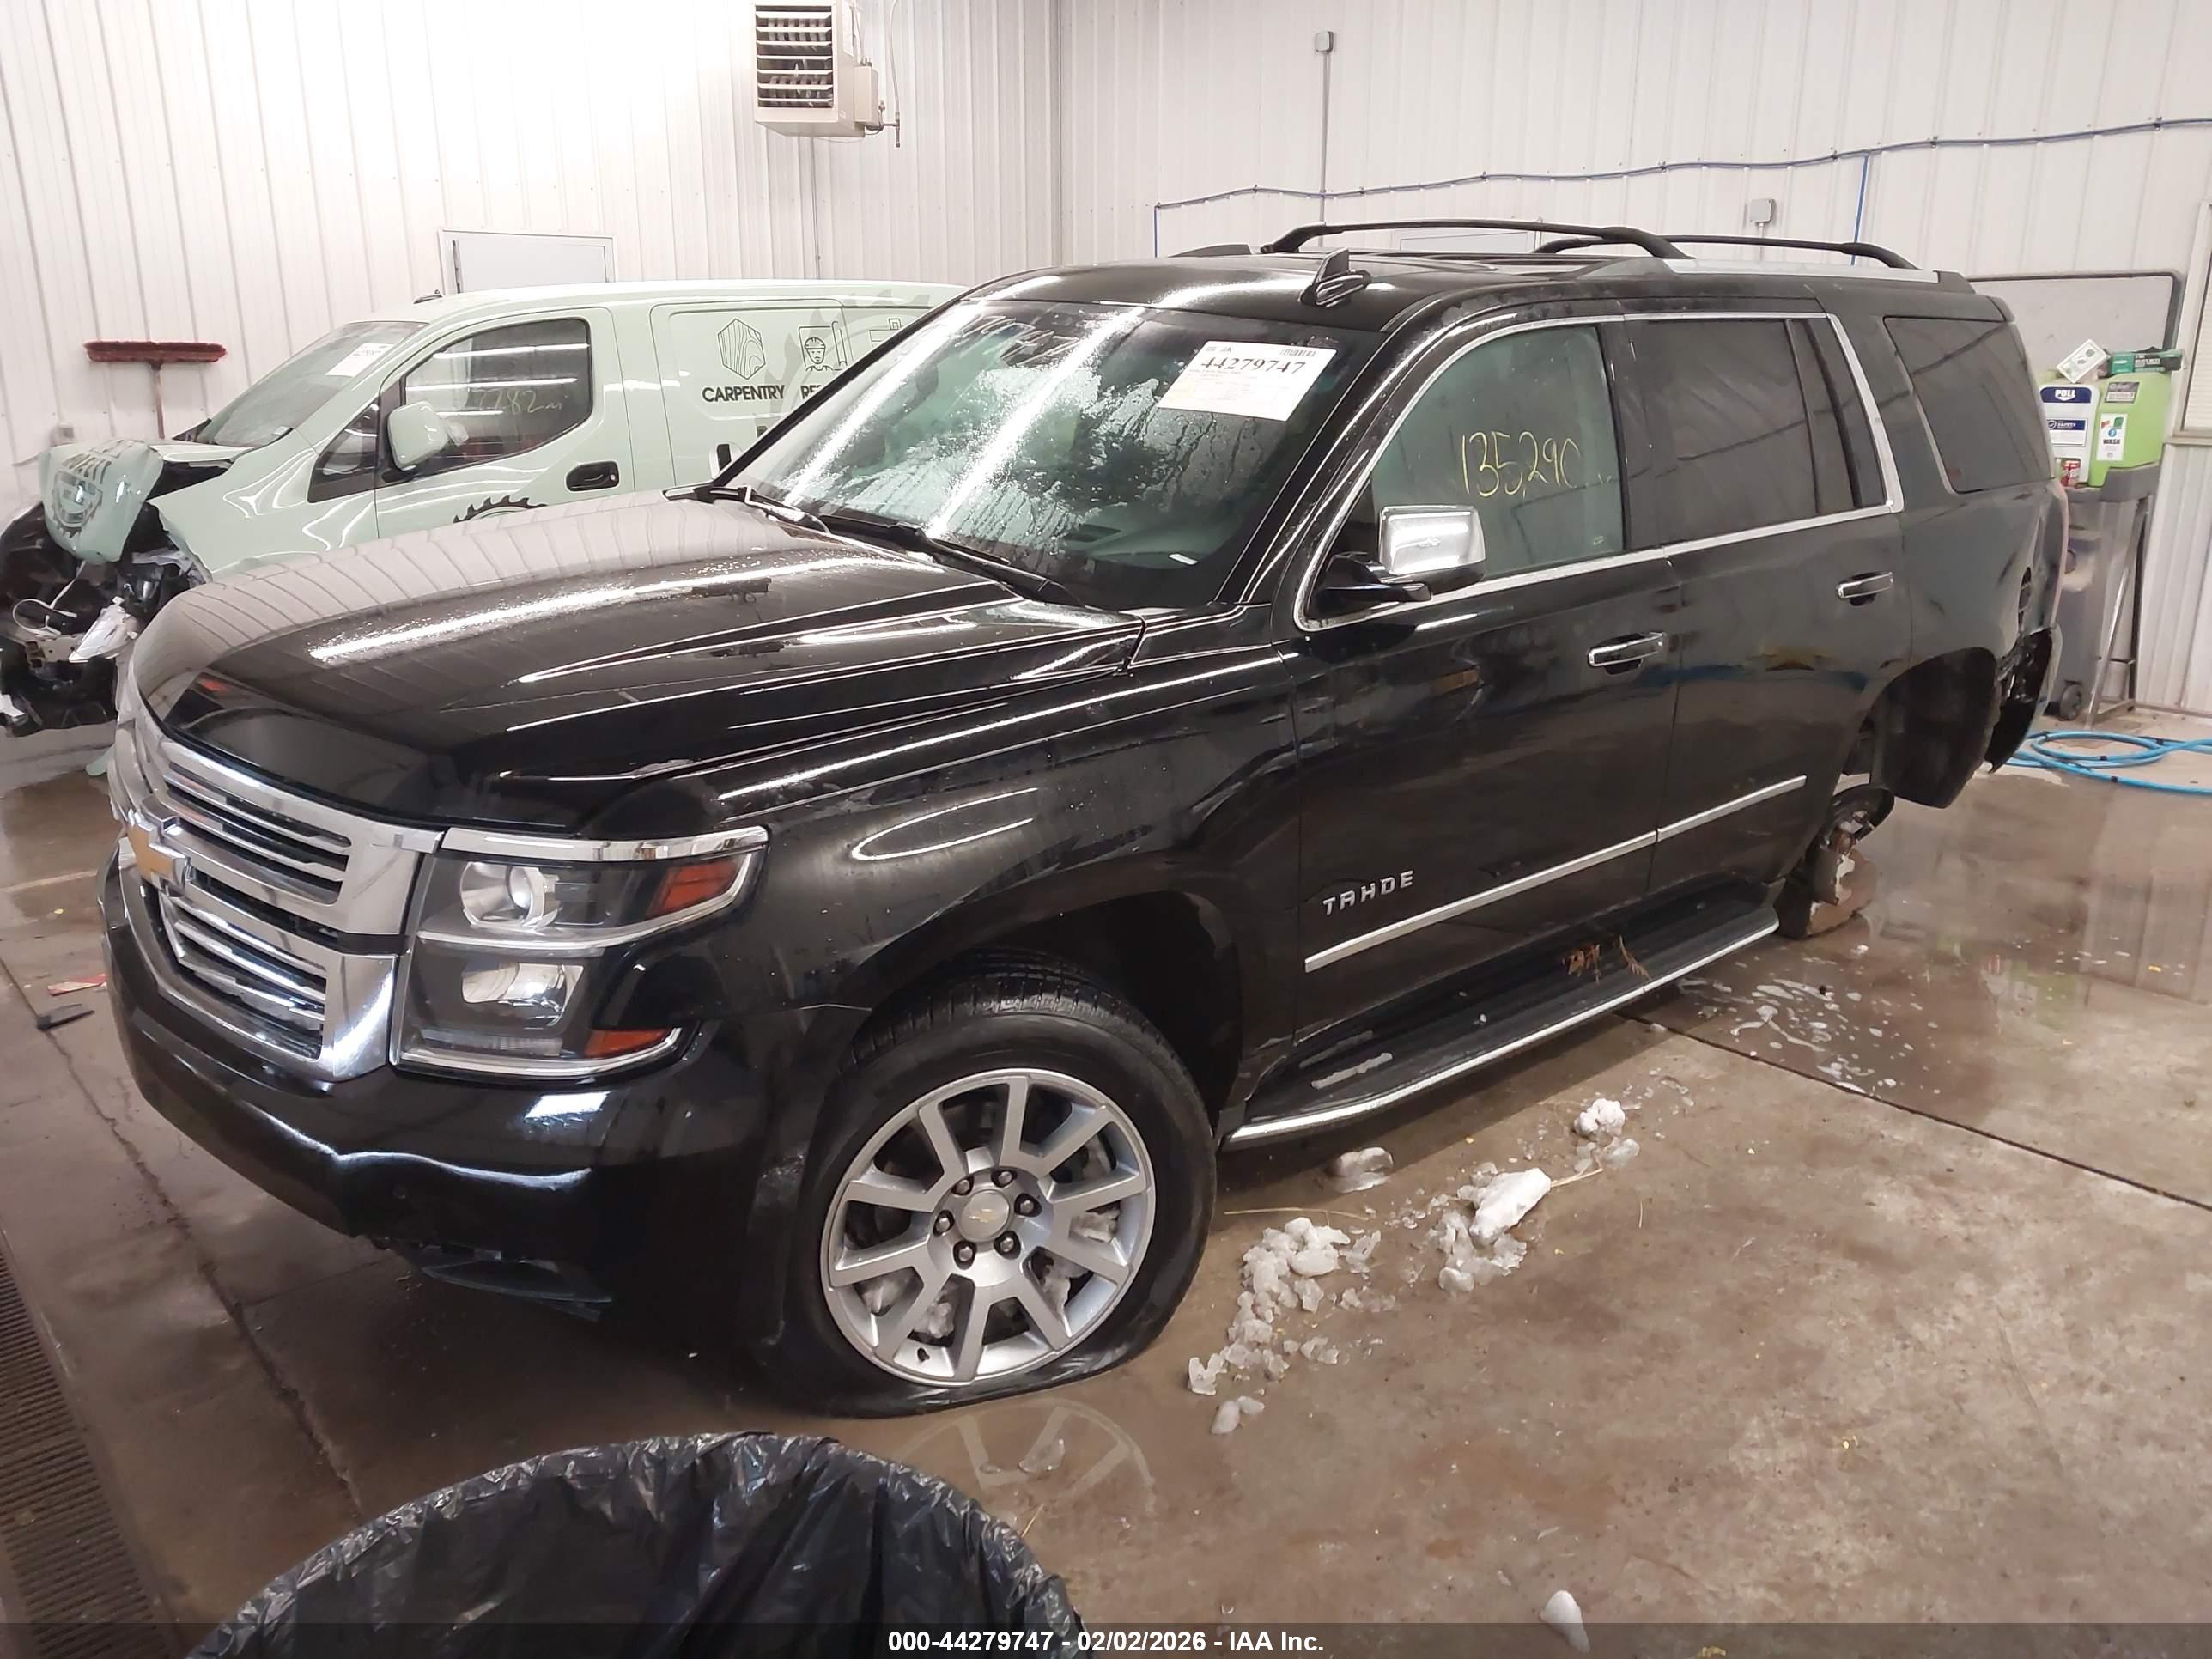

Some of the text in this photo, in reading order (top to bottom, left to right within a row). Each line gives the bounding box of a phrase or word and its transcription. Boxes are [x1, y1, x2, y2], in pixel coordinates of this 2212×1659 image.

[1201, 356, 1307, 374] 44279747
[702, 384, 786, 403] CARPENTRY
[2054, 389, 2076, 398] PULL
[1322, 869, 1415, 916] TAHOE
